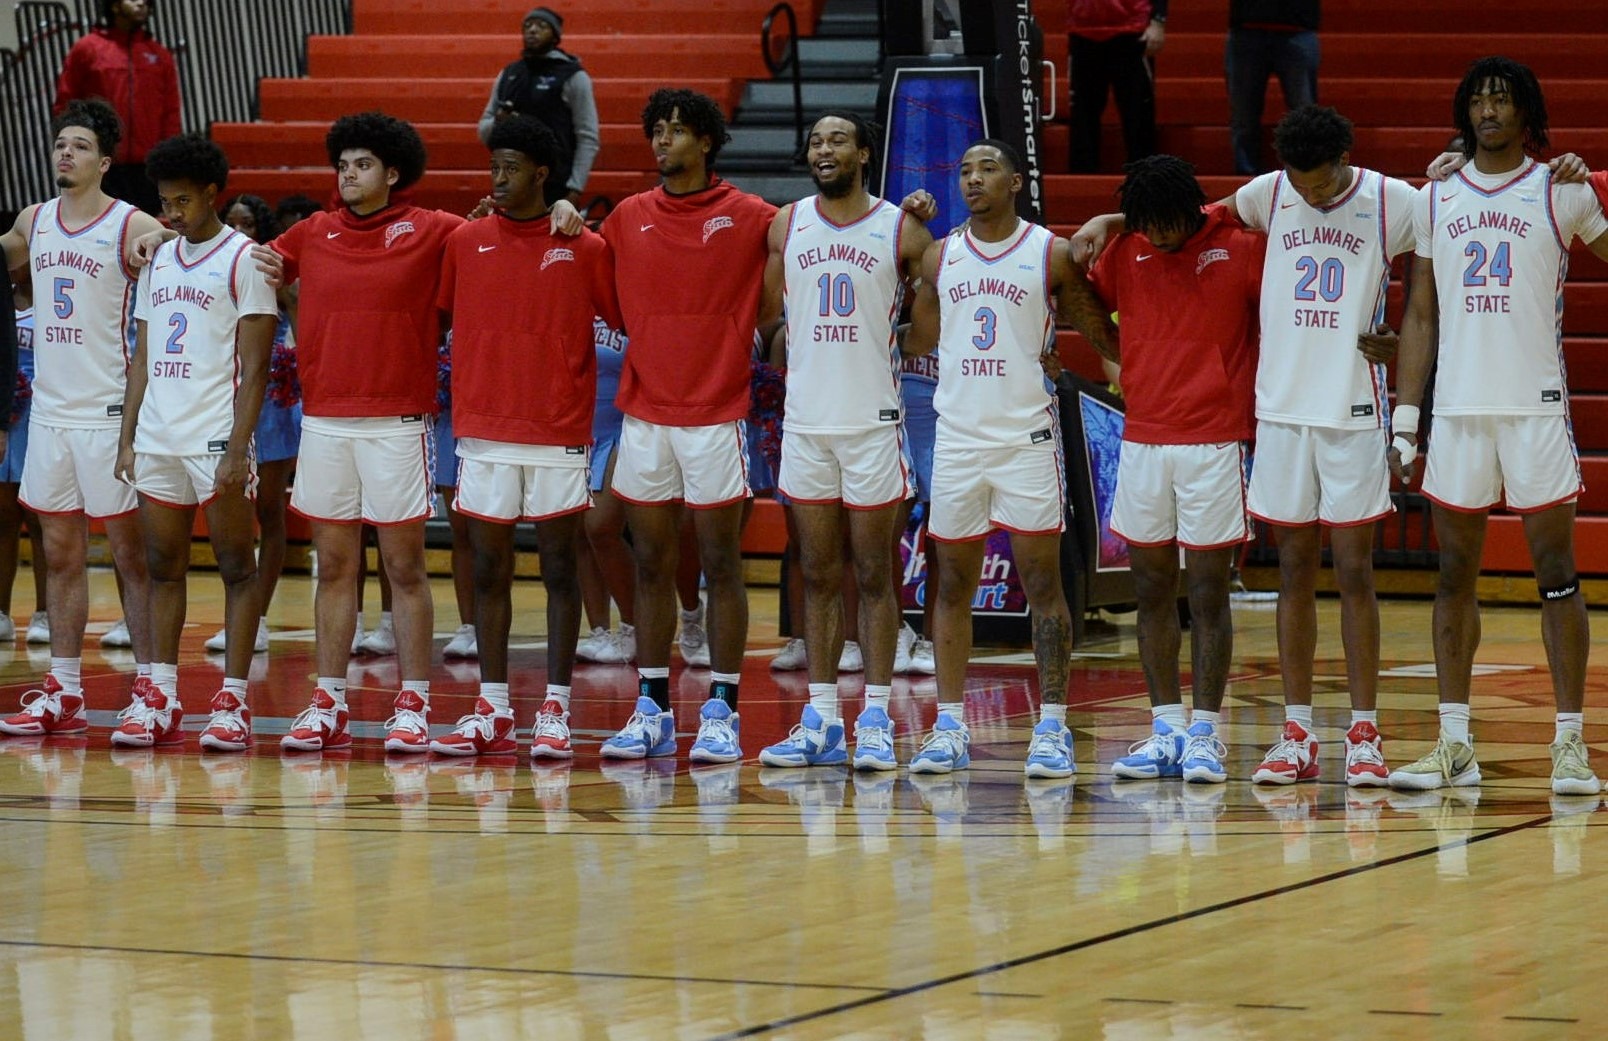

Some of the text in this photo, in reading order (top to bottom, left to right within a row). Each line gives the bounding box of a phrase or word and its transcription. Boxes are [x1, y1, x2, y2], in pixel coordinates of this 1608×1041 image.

[1447, 211, 1532, 240] DELAWARE
[1282, 227, 1366, 256] DELAWARE
[35, 250, 104, 279] DELAWARE
[797, 243, 880, 274] DELAWARE
[1463, 241, 1512, 287] 24
[949, 278, 1029, 307] DELAWARE
[1294, 256, 1344, 303] 20
[53, 277, 75, 319] 5
[152, 284, 215, 311] DELAWARE
[818, 273, 855, 317] 10
[1465, 295, 1511, 313] STATE
[165, 312, 188, 354] 2
[813, 324, 858, 343] STATE
[972, 306, 996, 350] 3
[1294, 309, 1340, 329] STATE
[45, 326, 83, 345] STATE
[154, 361, 192, 379] STATE
[962, 358, 1006, 377] STATE
